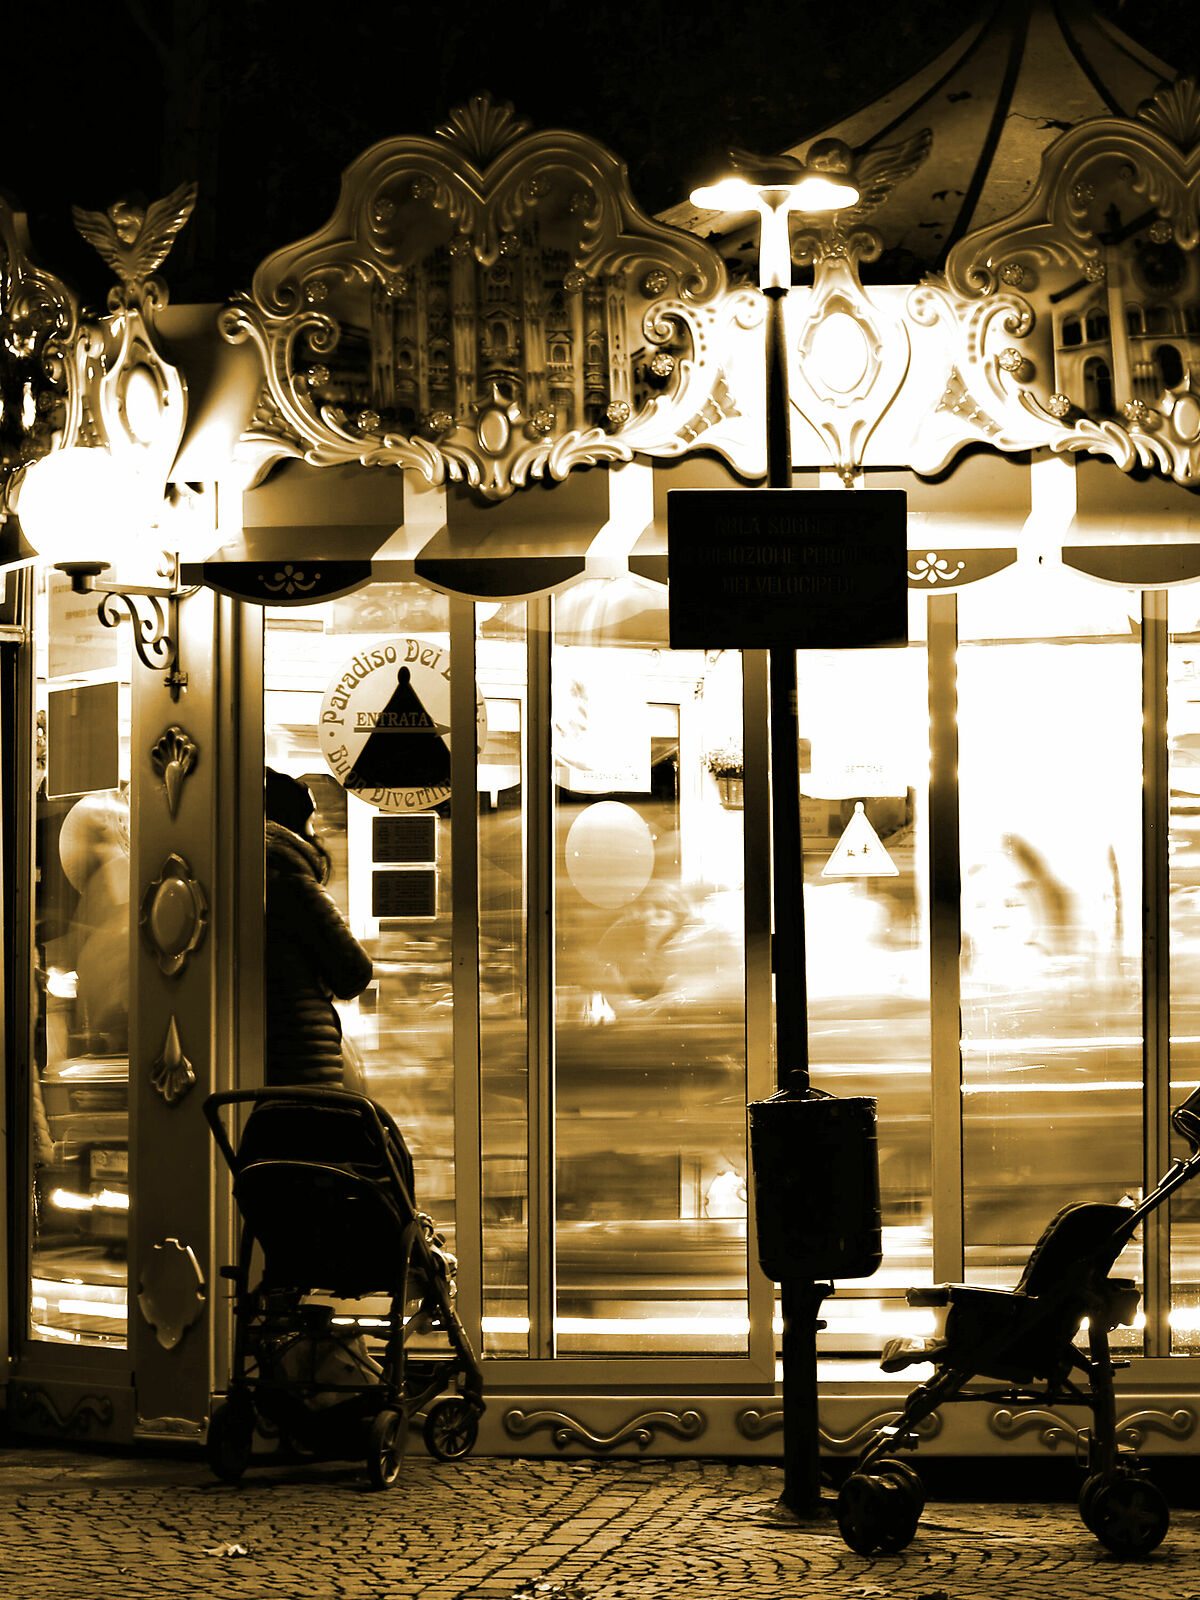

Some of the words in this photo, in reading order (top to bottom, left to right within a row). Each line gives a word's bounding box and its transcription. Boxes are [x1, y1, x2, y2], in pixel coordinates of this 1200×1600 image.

[322, 646, 397, 726] Paradiso
[404, 639, 443, 669] Dei
[356, 712, 430, 727] ENTRATA
